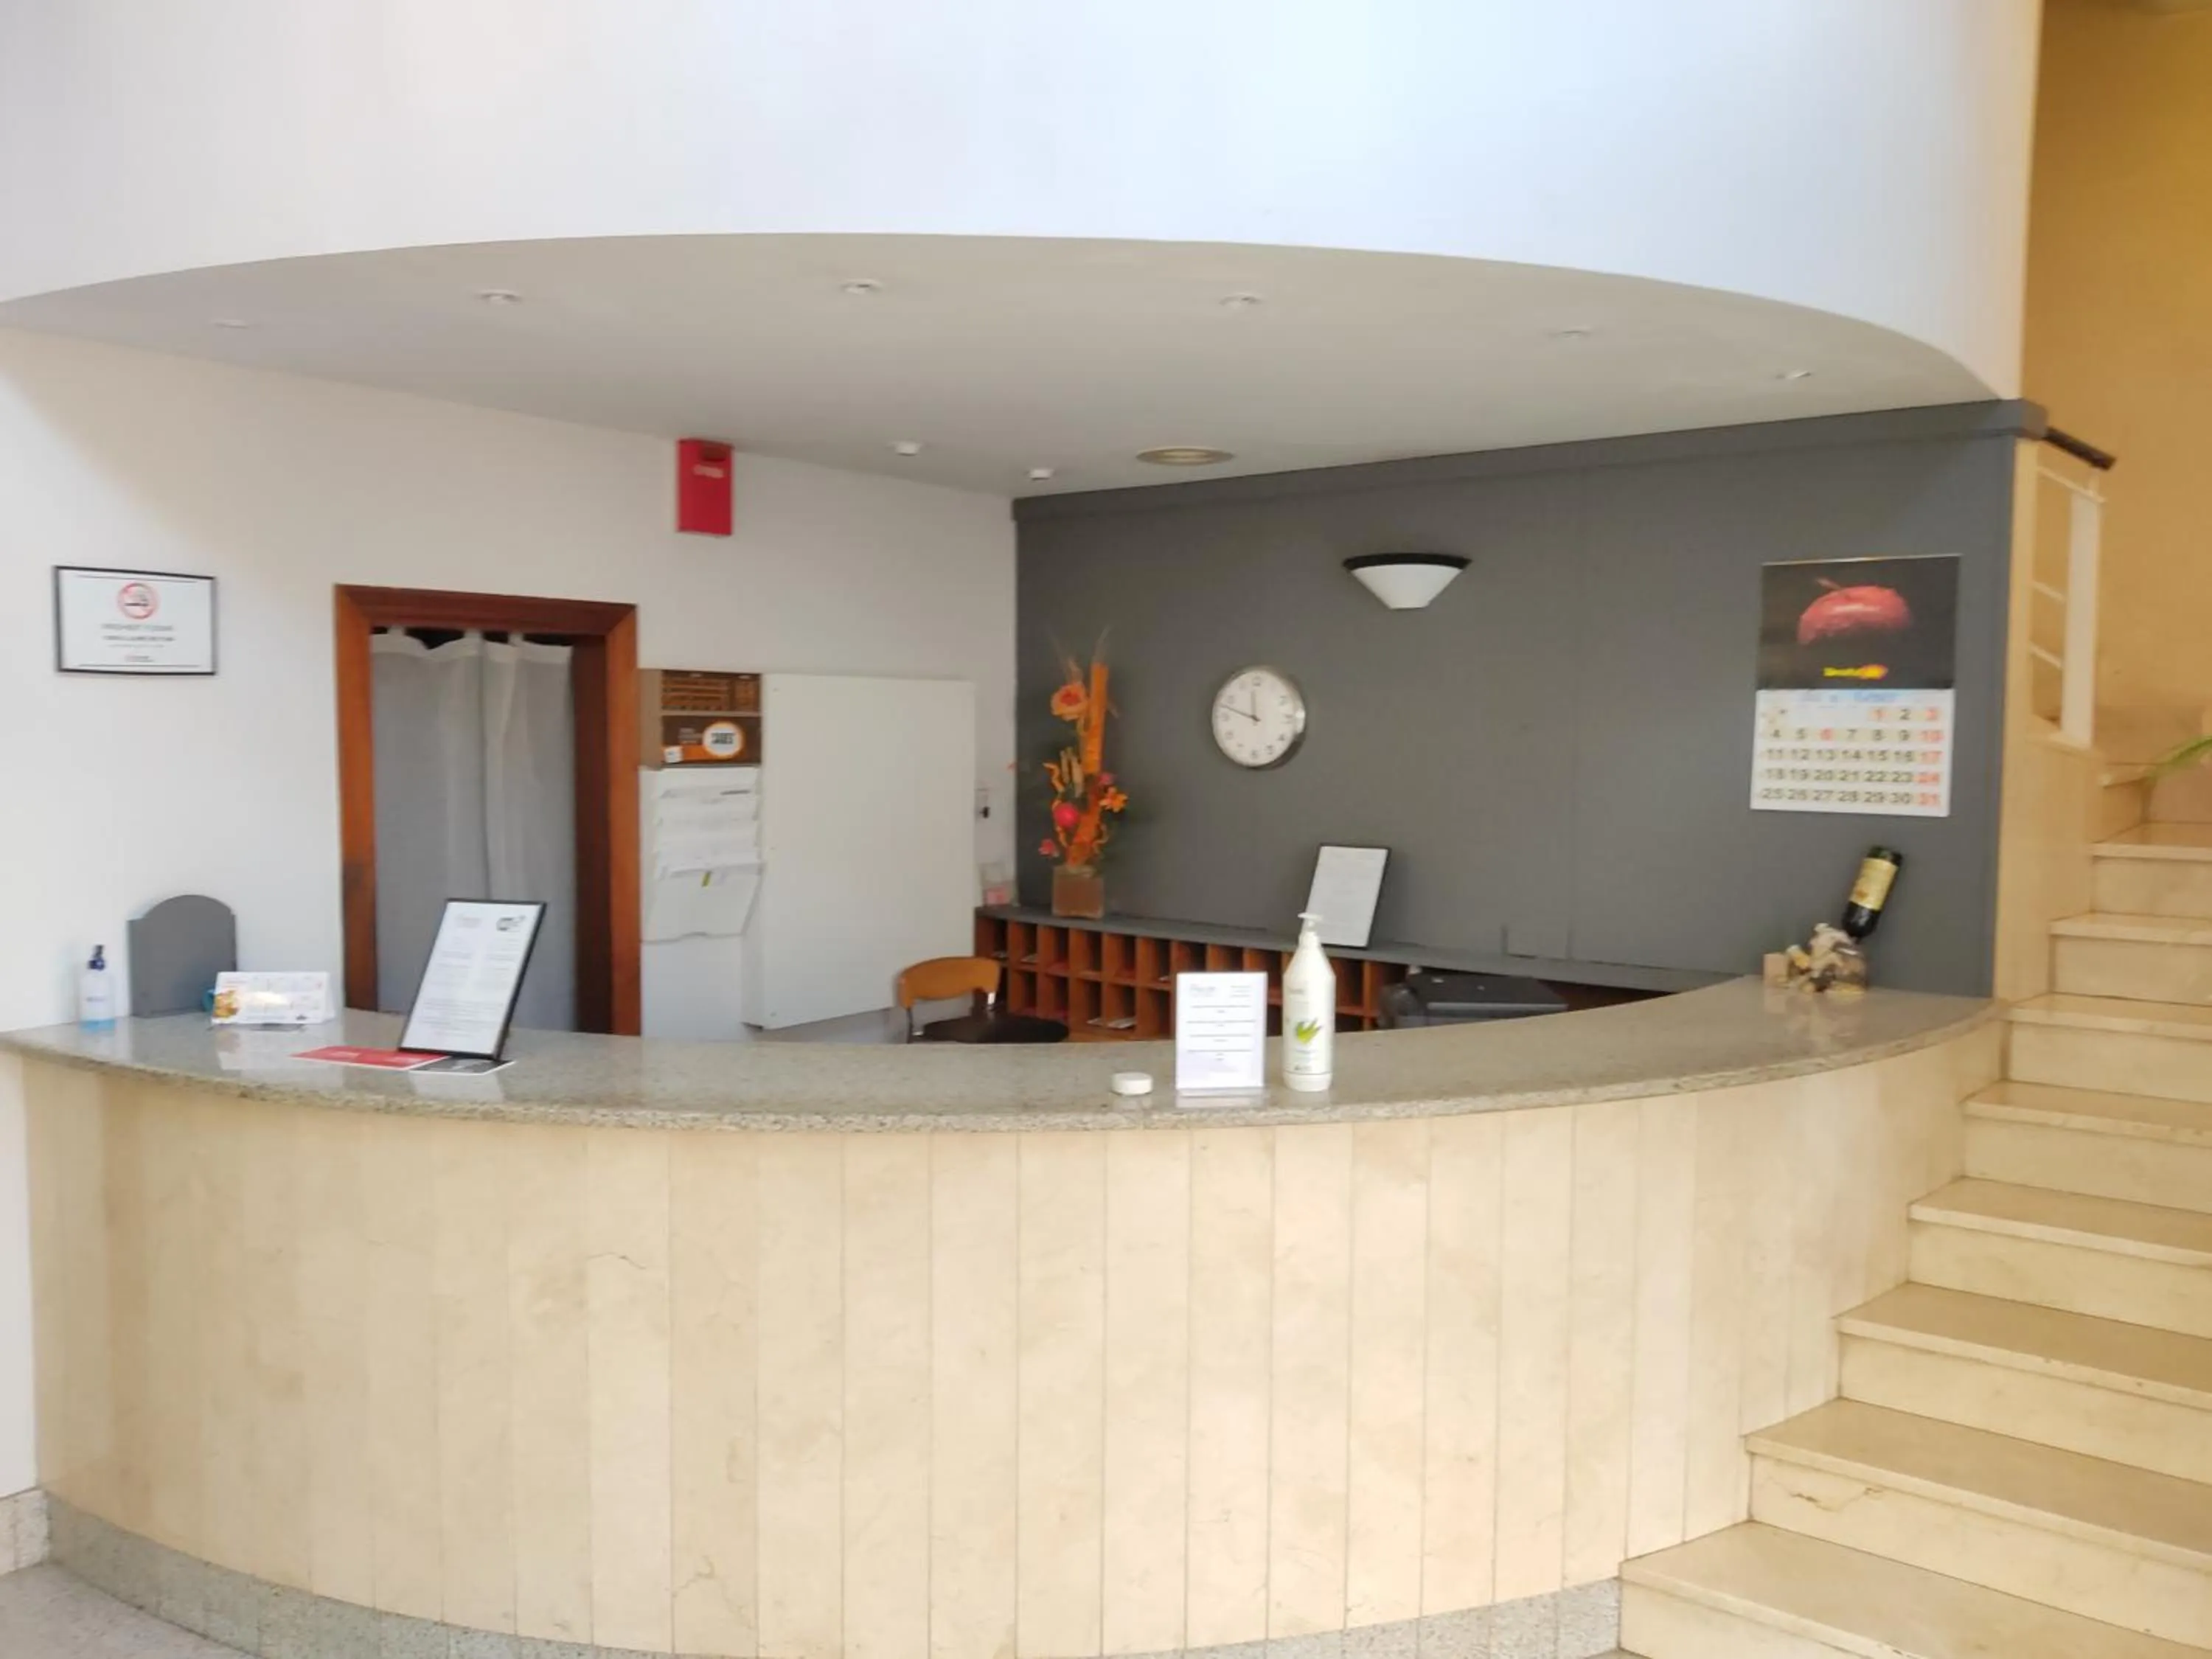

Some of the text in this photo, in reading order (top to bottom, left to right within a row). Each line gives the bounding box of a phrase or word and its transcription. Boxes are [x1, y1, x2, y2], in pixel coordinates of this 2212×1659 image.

[1899, 709, 1911, 720] 2
[1846, 728, 1857, 741] 7
[1899, 729, 1910, 741] 9
[1790, 748, 1809, 760] 12
[1816, 749, 1834, 761] 13
[1841, 749, 1863, 760] 14
[1867, 750, 1888, 761] 15
[1814, 769, 1833, 781] 20
[1839, 770, 1859, 781] 21
[1864, 771, 1887, 782] 22
[1813, 790, 1834, 801] 27
[1838, 790, 1858, 802] 28
[1863, 791, 1885, 803] 29
[1890, 792, 1911, 804] 30
